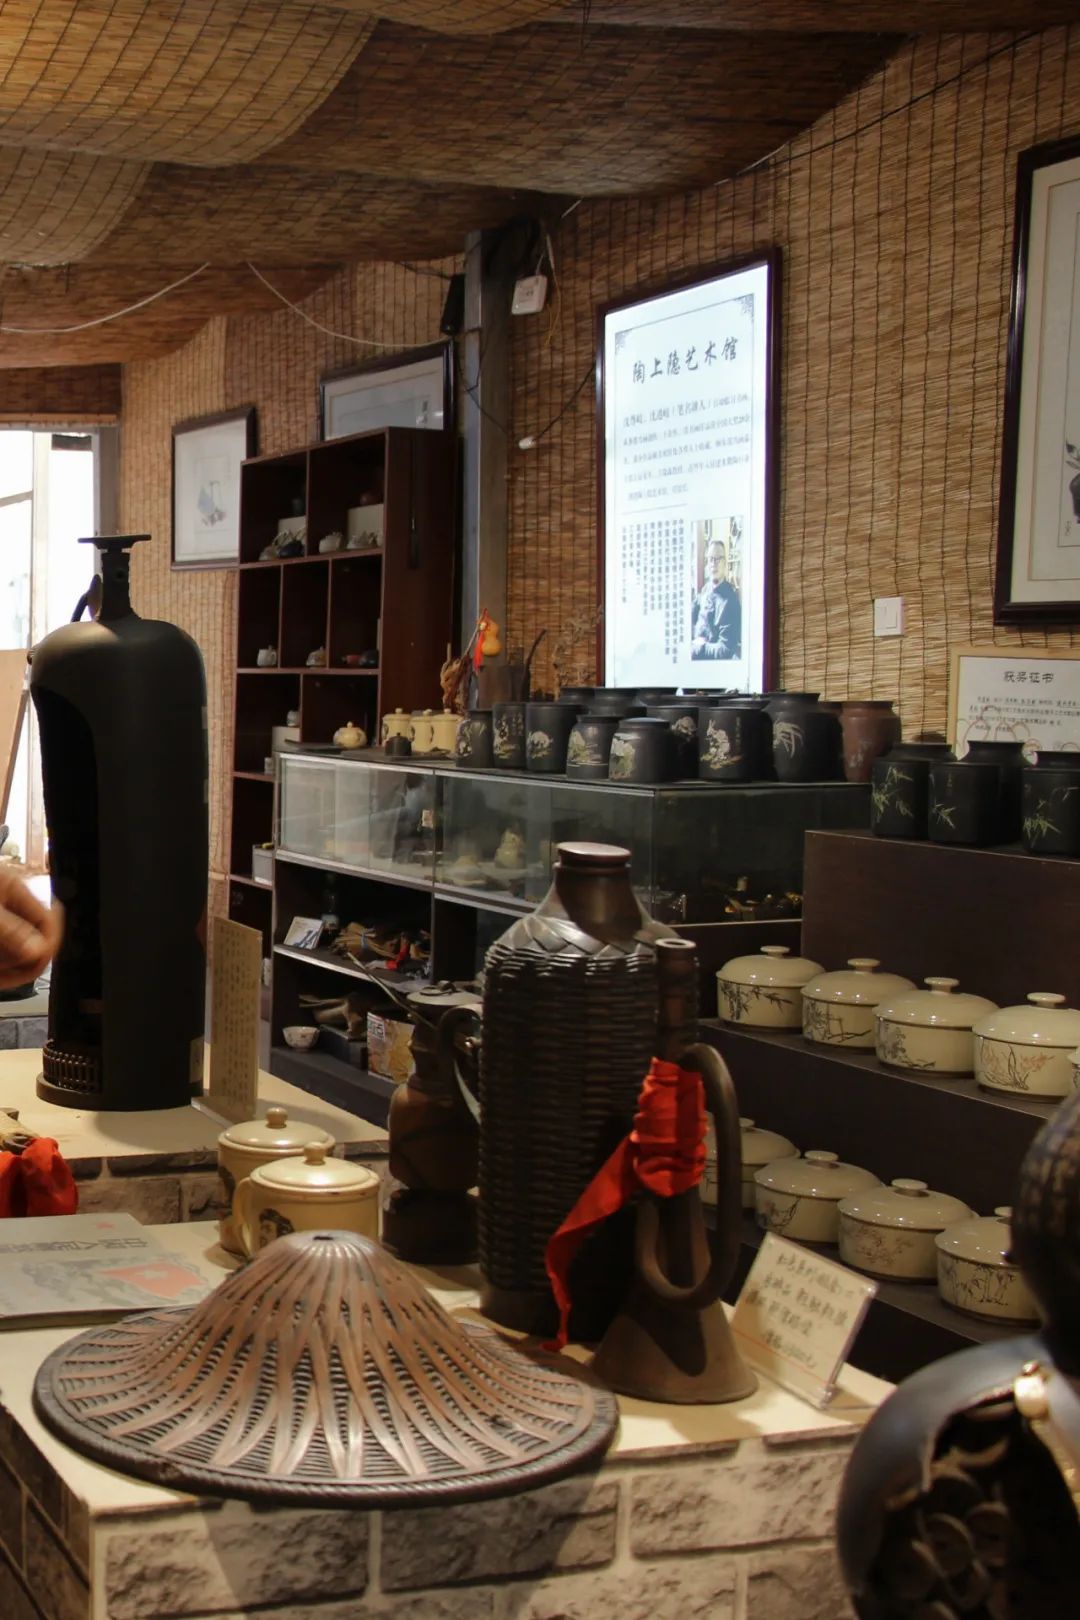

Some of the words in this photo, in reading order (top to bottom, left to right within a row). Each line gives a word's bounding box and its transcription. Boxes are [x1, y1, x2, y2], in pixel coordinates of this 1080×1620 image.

[632, 336, 739, 385] 陶上隐艺术馆
